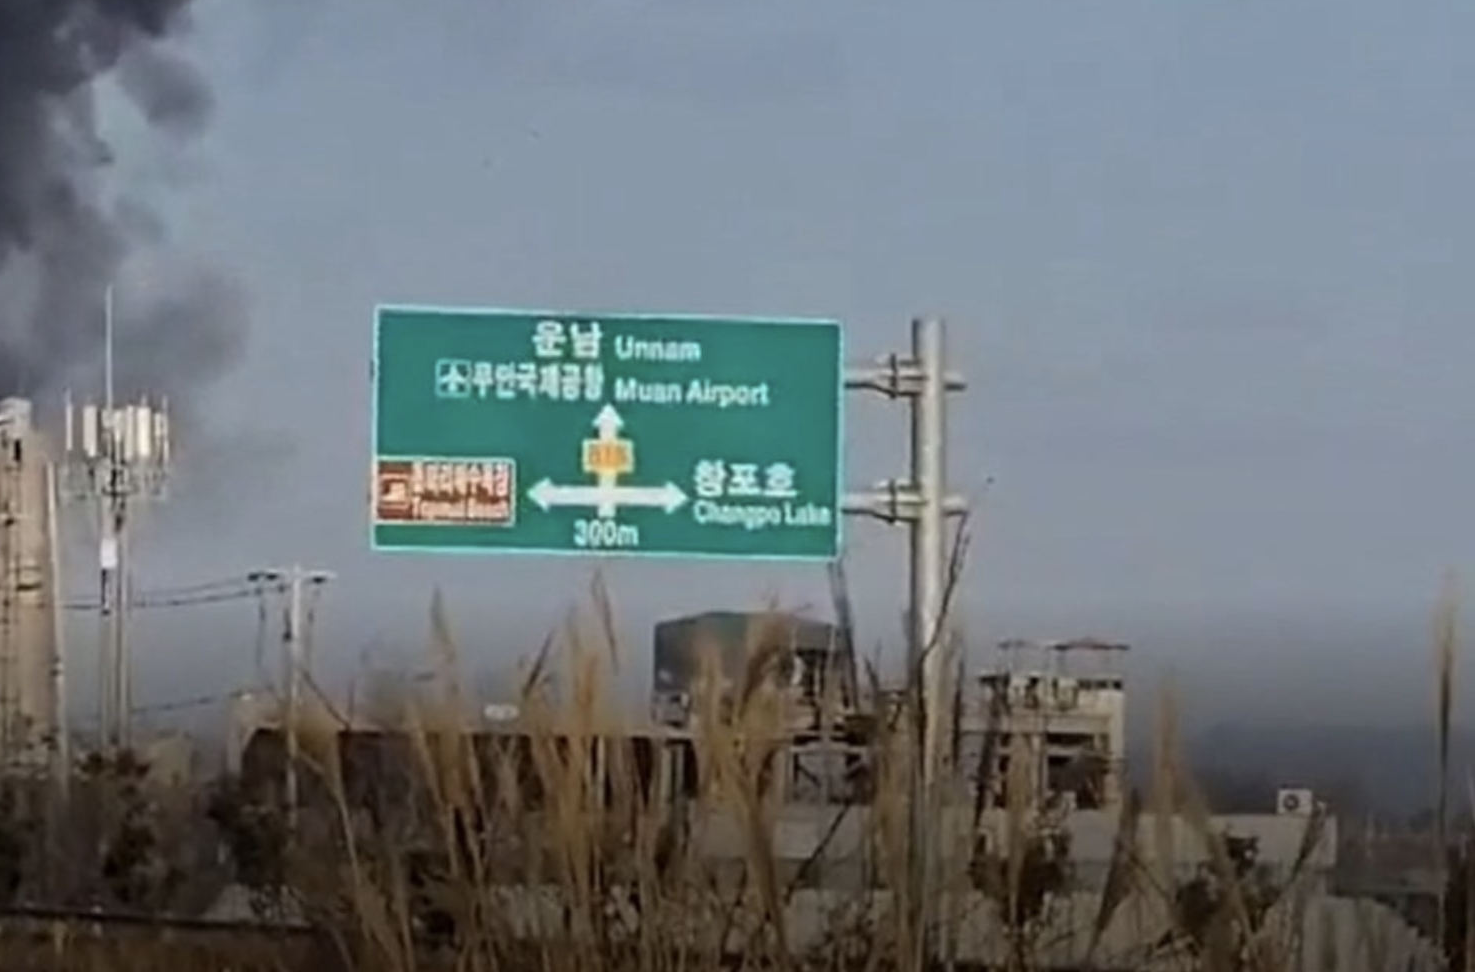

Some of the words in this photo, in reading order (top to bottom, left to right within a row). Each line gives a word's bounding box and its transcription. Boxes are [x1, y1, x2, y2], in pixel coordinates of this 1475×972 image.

[531, 320, 603, 358] 운남
[614, 335, 703, 361] Unnam
[614, 377, 683, 404] Muan
[686, 379, 771, 409] Airport
[573, 518, 640, 547] 300m
